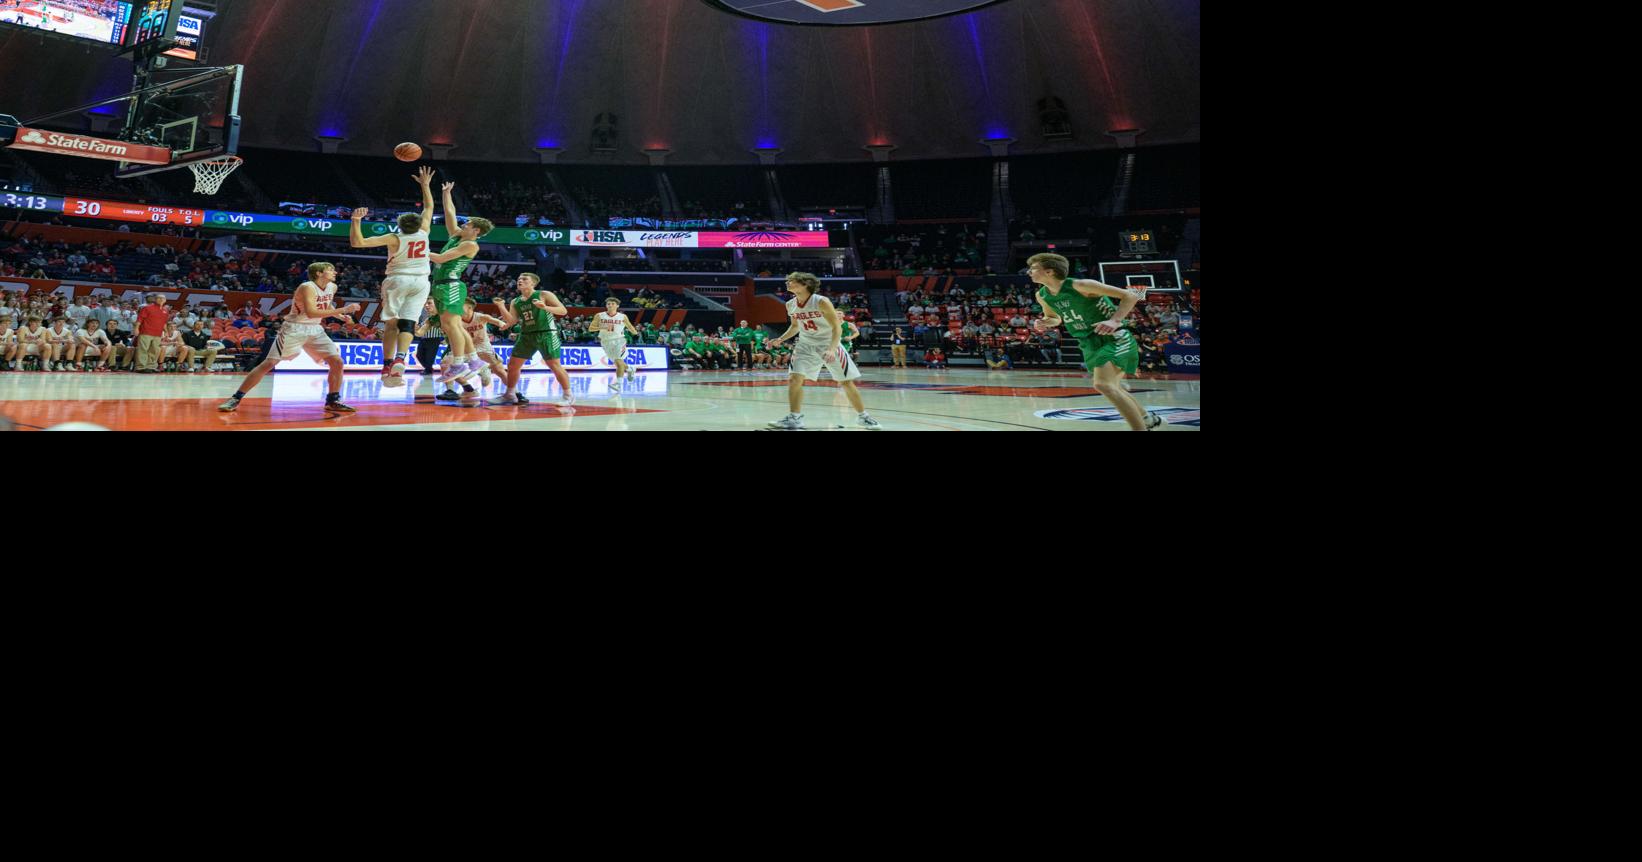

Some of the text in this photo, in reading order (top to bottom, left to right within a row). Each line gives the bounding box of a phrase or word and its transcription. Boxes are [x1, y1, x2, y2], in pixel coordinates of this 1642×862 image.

[4, 193, 101, 216] 3:13 30
[147, 206, 173, 214] FOULS
[151, 213, 167, 222] 03
[184, 215, 192, 224] 5
[229, 213, 253, 226] vip
[308, 219, 332, 231] vip
[540, 229, 563, 241] vip
[582, 230, 625, 243] IHSA
[640, 231, 692, 241] LEGENDS
[407, 241, 426, 258] 12
[803, 320, 817, 331] 14
